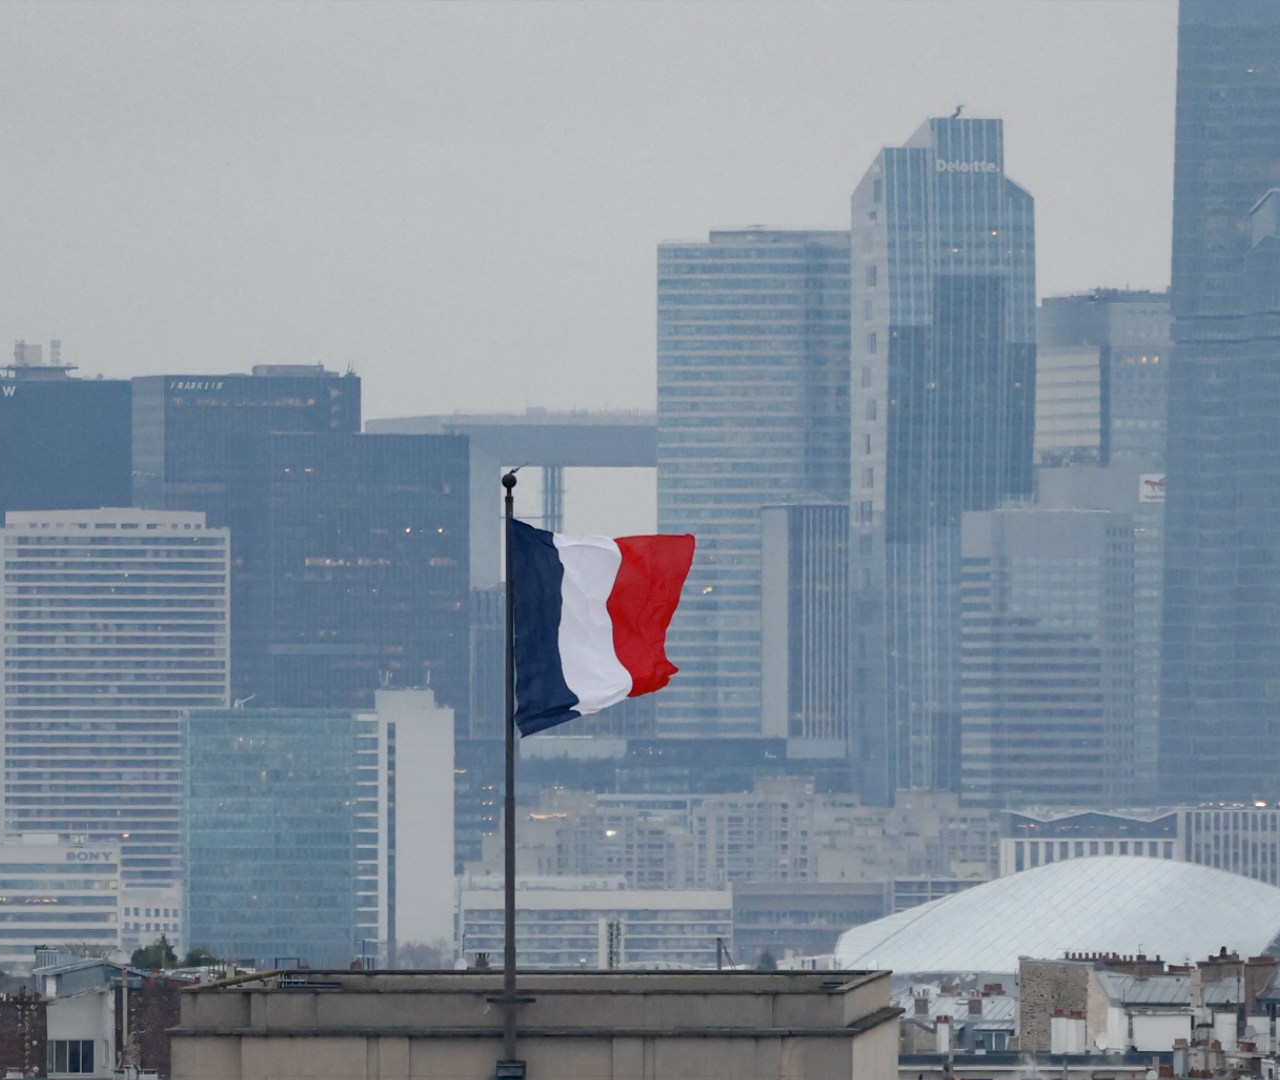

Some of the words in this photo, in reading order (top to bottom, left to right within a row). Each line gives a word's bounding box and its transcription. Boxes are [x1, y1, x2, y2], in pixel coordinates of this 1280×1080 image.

[2, 385, 17, 398] W
[170, 381, 224, 391] FRANKLIN
[66, 851, 113, 862] SONY
